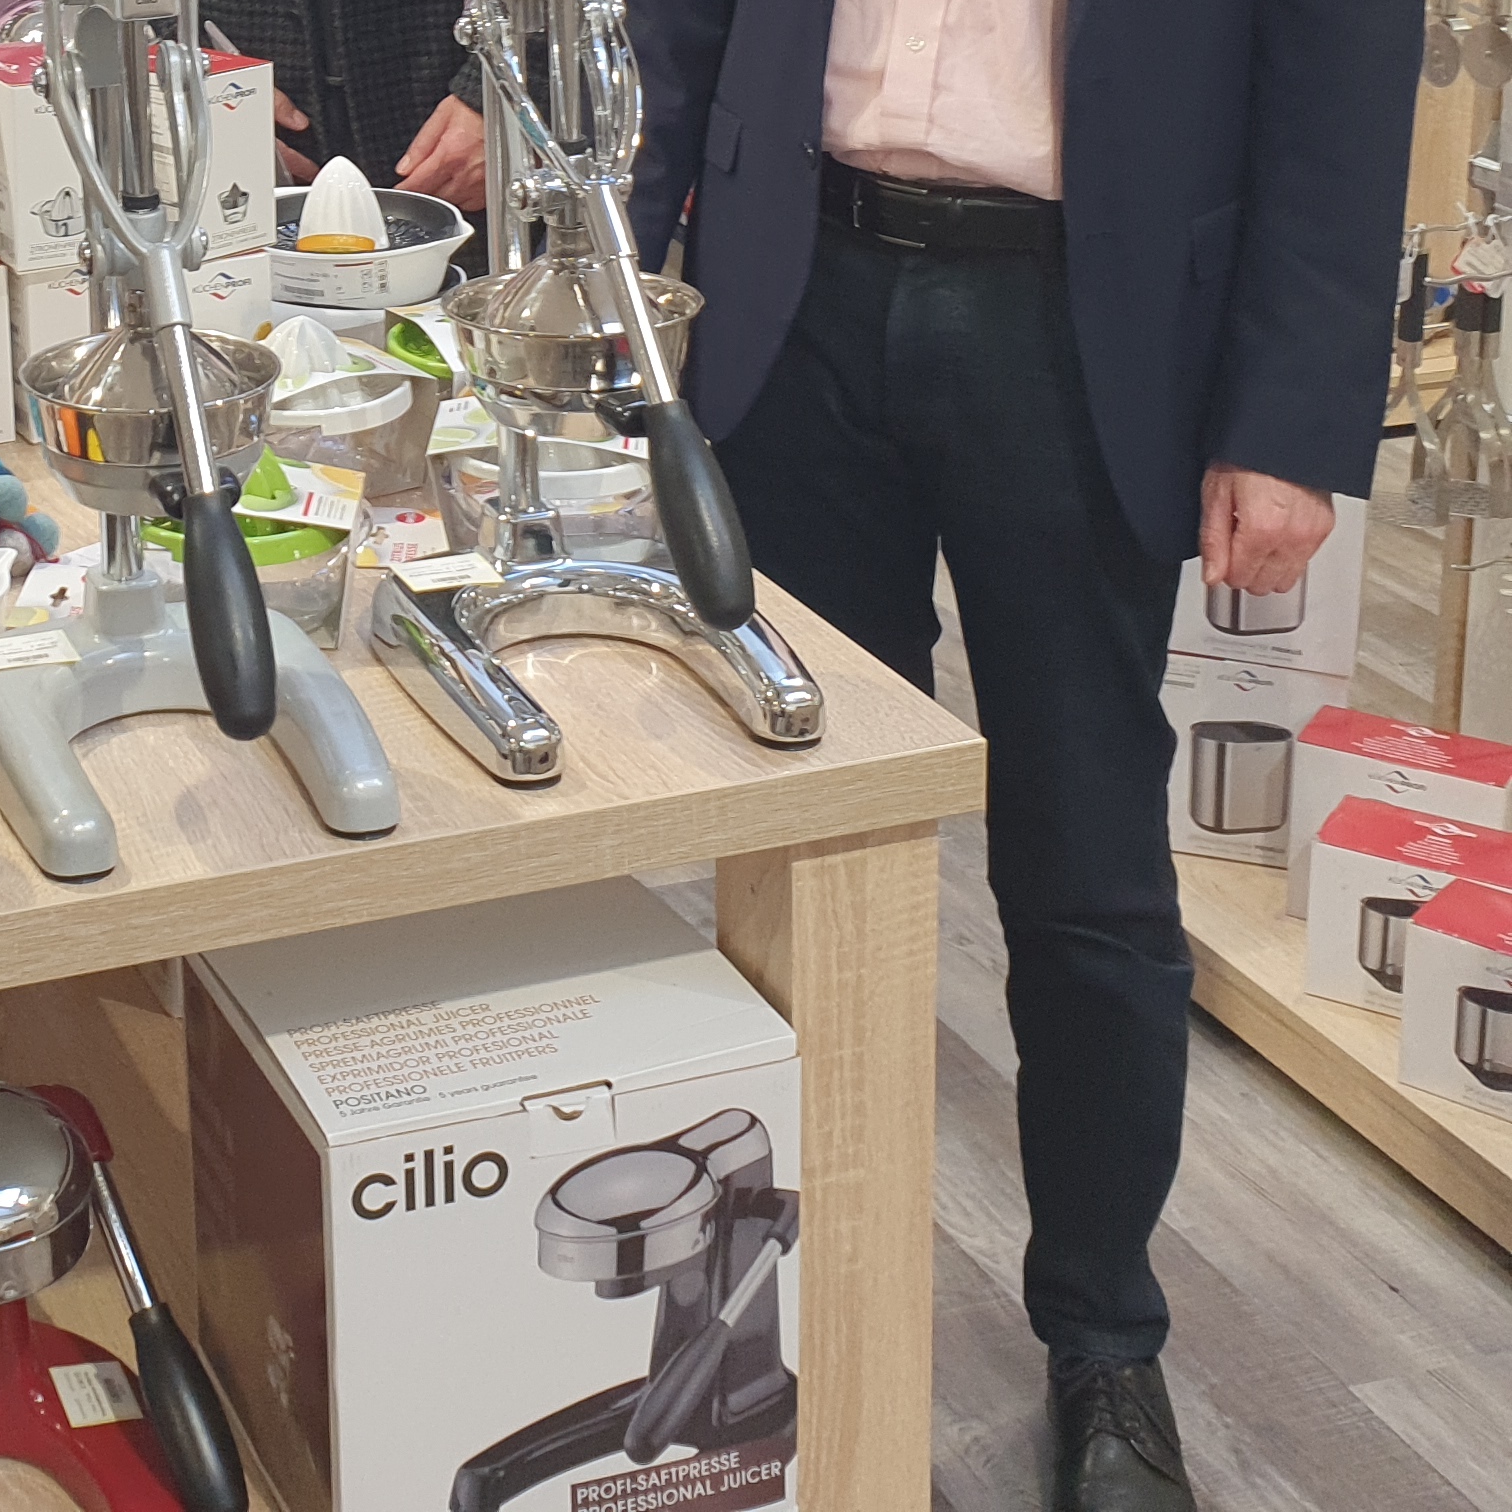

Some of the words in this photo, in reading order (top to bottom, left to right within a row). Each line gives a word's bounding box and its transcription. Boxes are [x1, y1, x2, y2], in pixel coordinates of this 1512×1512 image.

[287, 1000, 442, 1038] PROFI-SAFTPRESSE
[293, 1016, 424, 1050] PROFESSIONAL
[431, 1002, 492, 1024] JUICER
[301, 1022, 457, 1061] PRESSE-AGRUMES
[459, 993, 601, 1030] PROFESSIONNEL
[307, 1038, 450, 1074] SPREMIAGRUMI
[453, 1007, 593, 1045] PROFESSIONALE
[317, 1055, 432, 1086] EXPRIMIDOR
[437, 1028, 559, 1064] PROFESIONAL
[324, 1061, 467, 1098] PROFESSIONELE
[471, 1043, 559, 1070] FRUITPERS
[332, 1084, 428, 1110] POSITANO
[382, 1096, 431, 1110] Garantie
[351, 1144, 509, 1220] cilio
[576, 1451, 741, 1505] PROFI-SAFTPRESSE
[720, 1460, 783, 1492] JUICER
